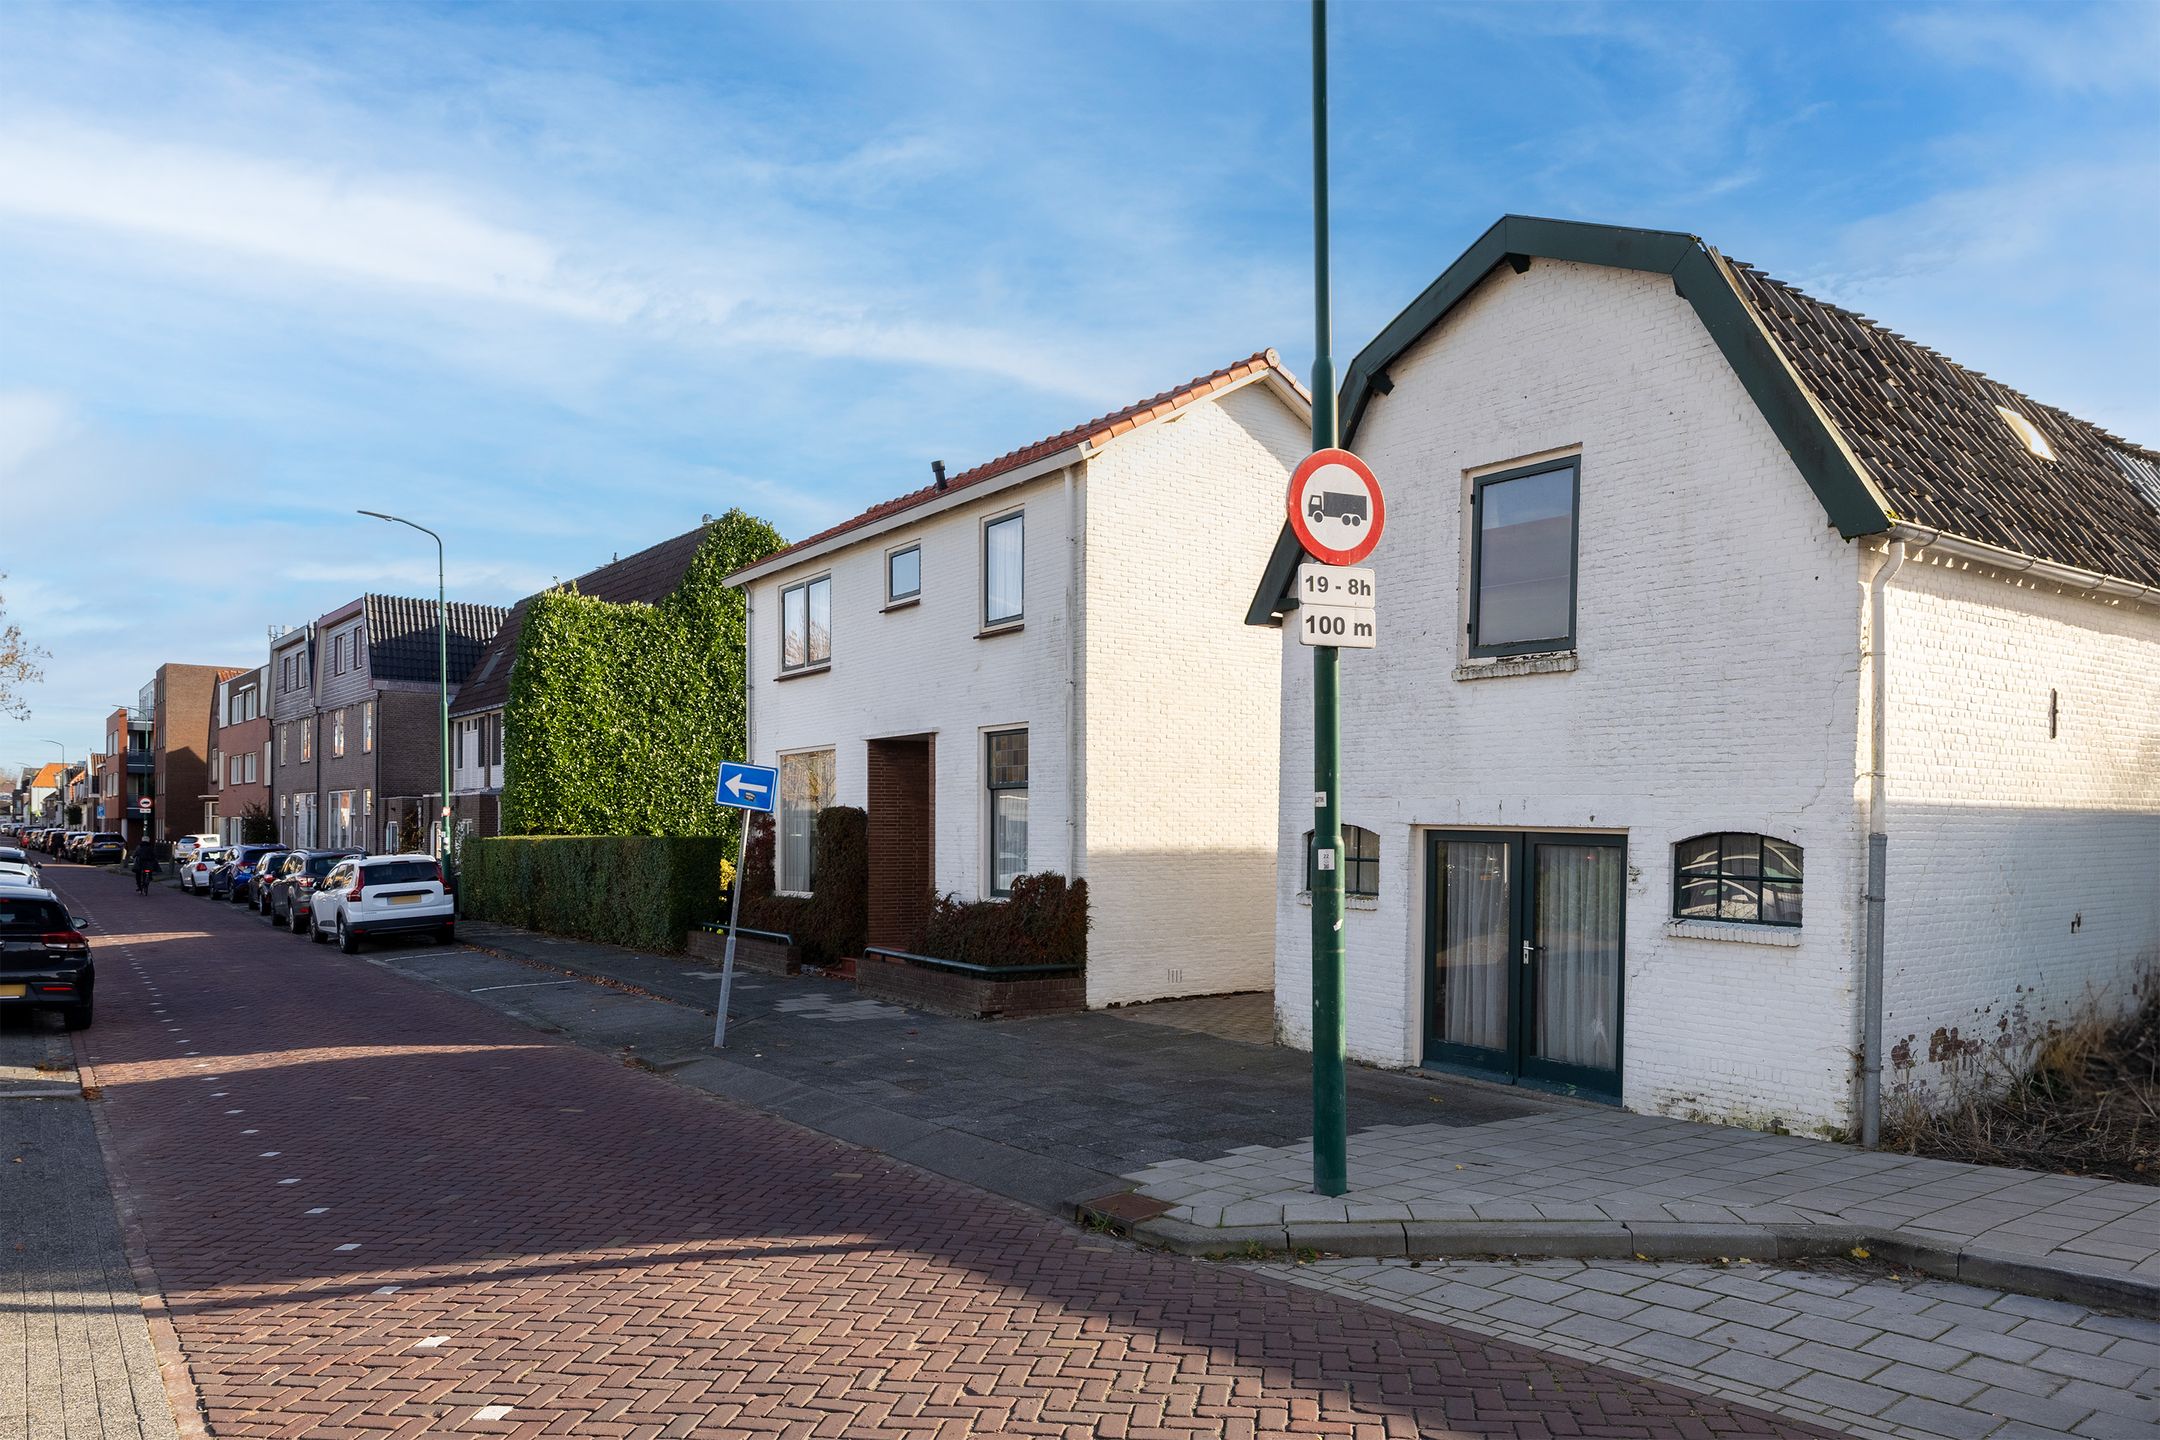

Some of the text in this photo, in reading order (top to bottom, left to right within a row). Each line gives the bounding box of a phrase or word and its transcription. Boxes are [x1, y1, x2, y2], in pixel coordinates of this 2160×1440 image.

[1305, 575, 1328, 593] 19
[1348, 579, 1371, 596] 8h
[1305, 615, 1373, 637] 100 m
